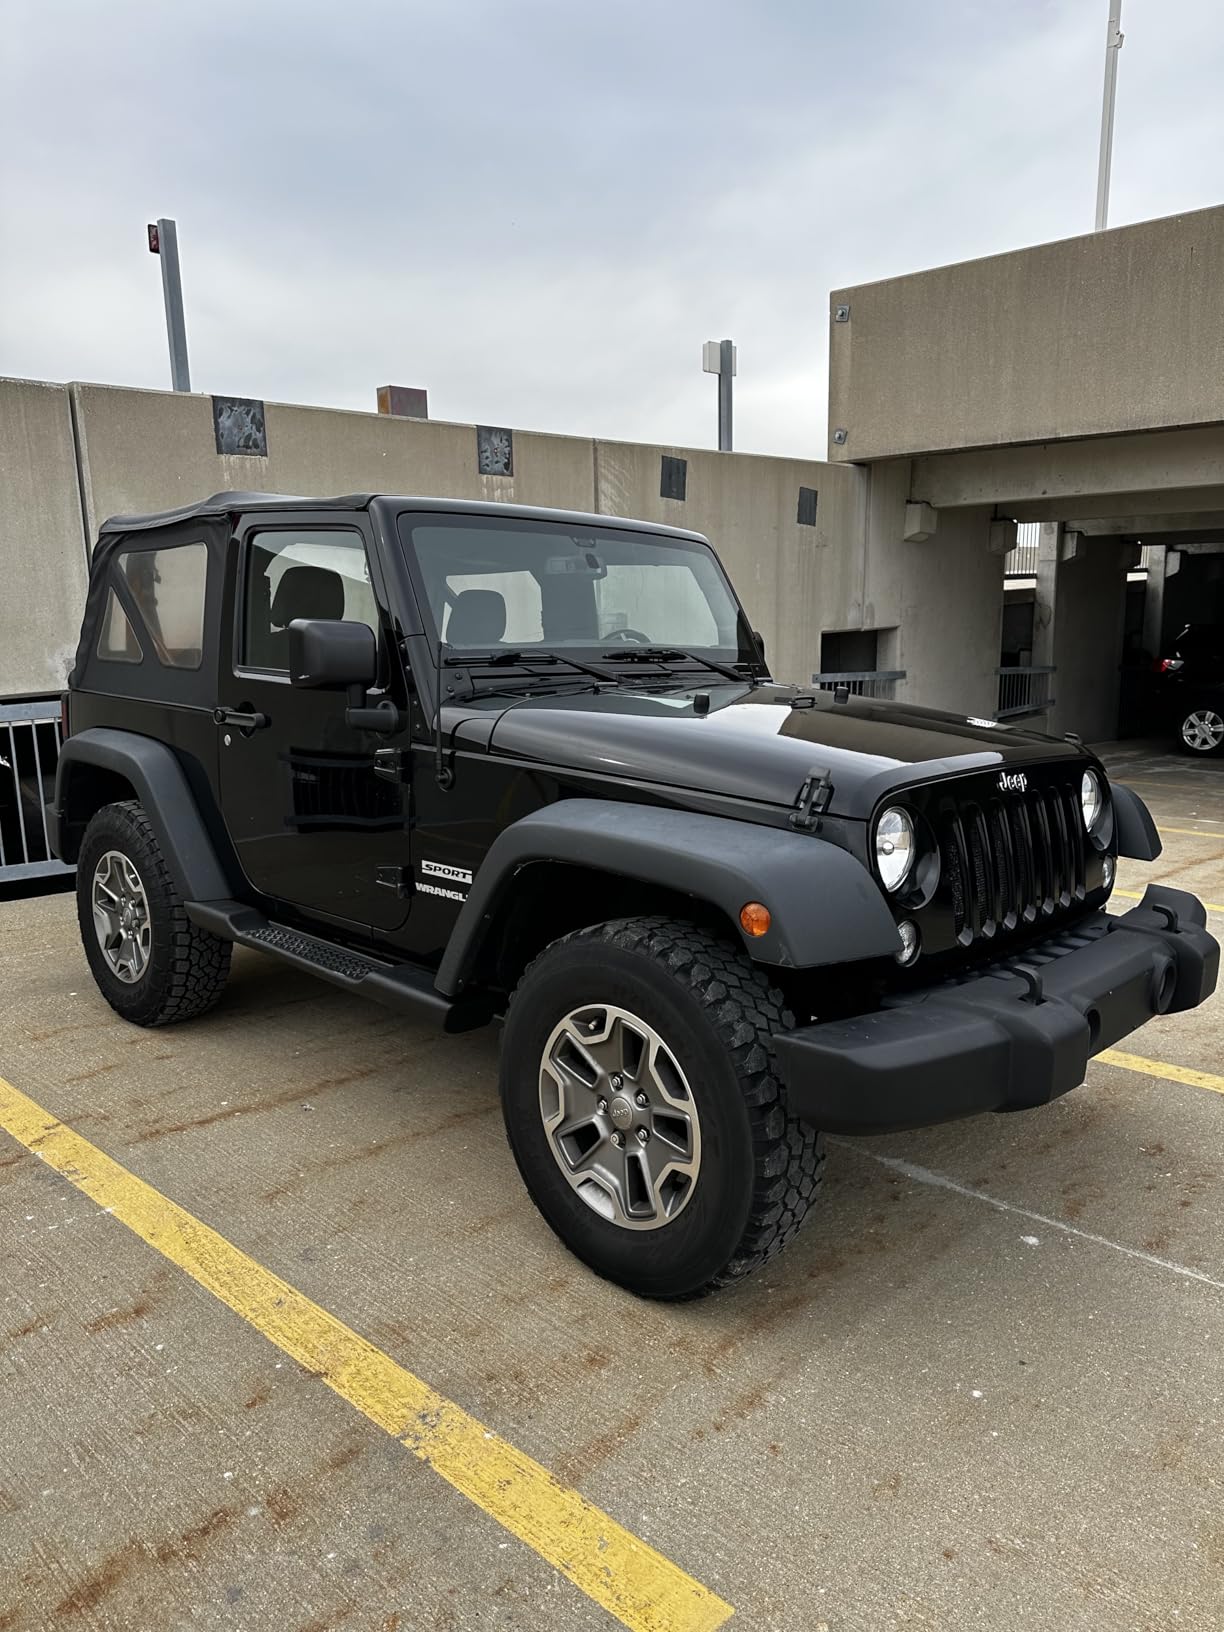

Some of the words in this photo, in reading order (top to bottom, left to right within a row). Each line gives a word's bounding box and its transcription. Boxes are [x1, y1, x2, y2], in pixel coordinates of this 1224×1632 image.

[997, 772, 1027, 792] Jeep
[422, 863, 473, 881] SPORT
[415, 882, 469, 902] WRANGL
